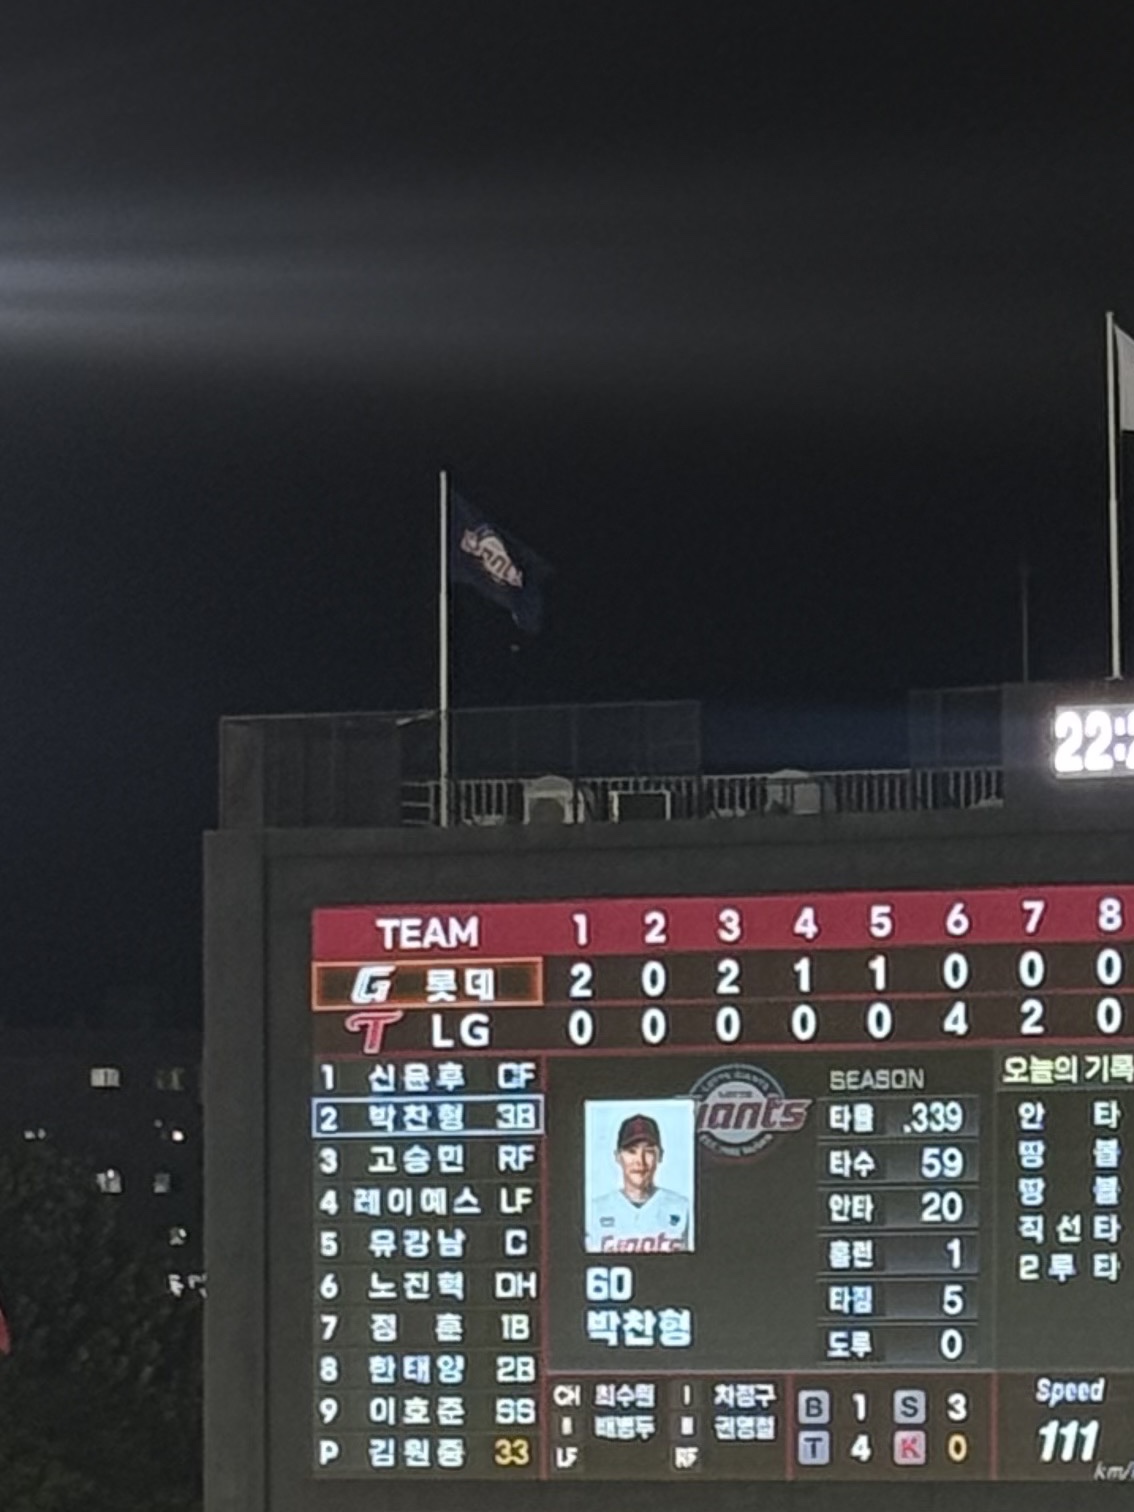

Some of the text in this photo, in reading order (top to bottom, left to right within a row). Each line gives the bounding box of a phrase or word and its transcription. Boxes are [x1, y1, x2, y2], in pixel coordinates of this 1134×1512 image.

[376, 916, 479, 949] TEAM
[573, 913, 588, 946] 1
[644, 911, 667, 944] 2
[718, 909, 742, 942] 3
[794, 906, 818, 939] 4
[870, 905, 892, 937] 5
[947, 903, 969, 935] 6
[1022, 901, 1045, 932] 7
[1100, 899, 1122, 930] 8
[426, 969, 495, 1002] 롯데
[570, 962, 592, 996] 2
[643, 962, 666, 996] 0
[718, 959, 740, 993] 2
[795, 958, 811, 992] 1
[432, 1015, 490, 1047] LG
[944, 1002, 968, 1035] 4
[1021, 1001, 1044, 1035] 2
[322, 1064, 334, 1090] 1
[498, 1063, 535, 1089] CF
[830, 1069, 924, 1090] SEASON
[1003, 1054, 1134, 1084] 오늘의 기록
[320, 1103, 535, 1131] 2 박찬형 3B
[904, 1102, 962, 1133] .339
[320, 1145, 535, 1173] 3 고승민 RF
[830, 1148, 962, 1178] 타수 59
[320, 1187, 532, 1215] 4 레이예스 LF
[829, 1191, 962, 1222] 안타 20
[320, 1229, 527, 1257] 5 유강남 C
[948, 1238, 960, 1269] 1
[320, 1273, 338, 1299] 6
[368, 1271, 464, 1300] 노진혁
[586, 1266, 632, 1300] 60
[943, 1285, 962, 1314] 5
[320, 1314, 530, 1340] 7 1B
[587, 1308, 691, 1346] 박찬형
[827, 1329, 962, 1359] 도루 0
[320, 1355, 535, 1384] 8 한태양 2B
[853, 1393, 967, 1420] 1 3
[1036, 1378, 1105, 1407] Speed
[320, 1398, 338, 1424] 9
[370, 1396, 465, 1425] 이호준
[320, 1439, 529, 1467] P 김원중 33
[851, 1434, 967, 1461] 4 0
[1039, 1420, 1099, 1461] 111
